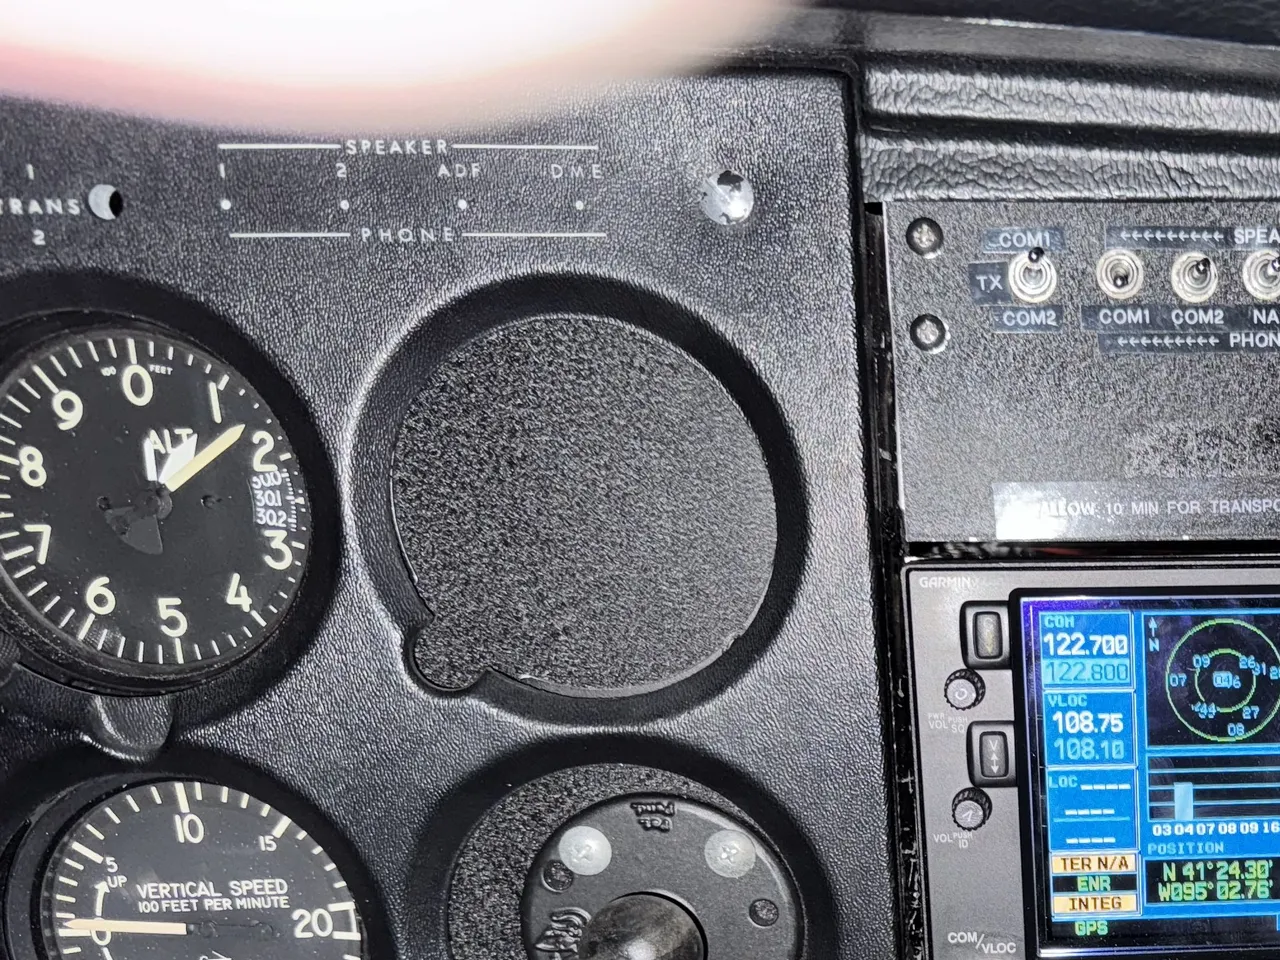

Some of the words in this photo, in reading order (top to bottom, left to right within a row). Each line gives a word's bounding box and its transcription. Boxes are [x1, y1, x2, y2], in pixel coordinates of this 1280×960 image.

[346, 139, 449, 155] SPEAKER
[438, 163, 481, 178] ADF
[550, 163, 602, 179] DME
[361, 228, 454, 243] PHONE
[1000, 230, 1051, 249] COM1
[976, 275, 1001, 291] TX
[1003, 310, 1057, 327] COM2
[1100, 309, 1151, 326] COM1
[1171, 309, 1225, 326] COM2
[51, 390, 84, 430] 9
[1131, 499, 1160, 515] MIN
[1167, 499, 1201, 515] FOR
[919, 576, 971, 589] GARMIN
[226, 573, 253, 613] 4
[1043, 633, 1128, 656] 122.700
[1046, 661, 1128, 682] 122.800
[1052, 710, 1124, 734] 108.75
[1053, 739, 1125, 761] 108.10
[1147, 841, 1225, 856] POSITION
[1060, 856, 1092, 872] TER
[1099, 854, 1130, 871] N/A
[136, 880, 221, 899] VERTICAL
[228, 878, 289, 897] SPEED
[1077, 875, 1112, 892] ENR
[162, 899, 200, 913] FEET
[203, 898, 233, 912] PER
[236, 895, 291, 911] MINUTE
[1068, 895, 1123, 912] INTEG
[1074, 920, 1109, 937] GPS
